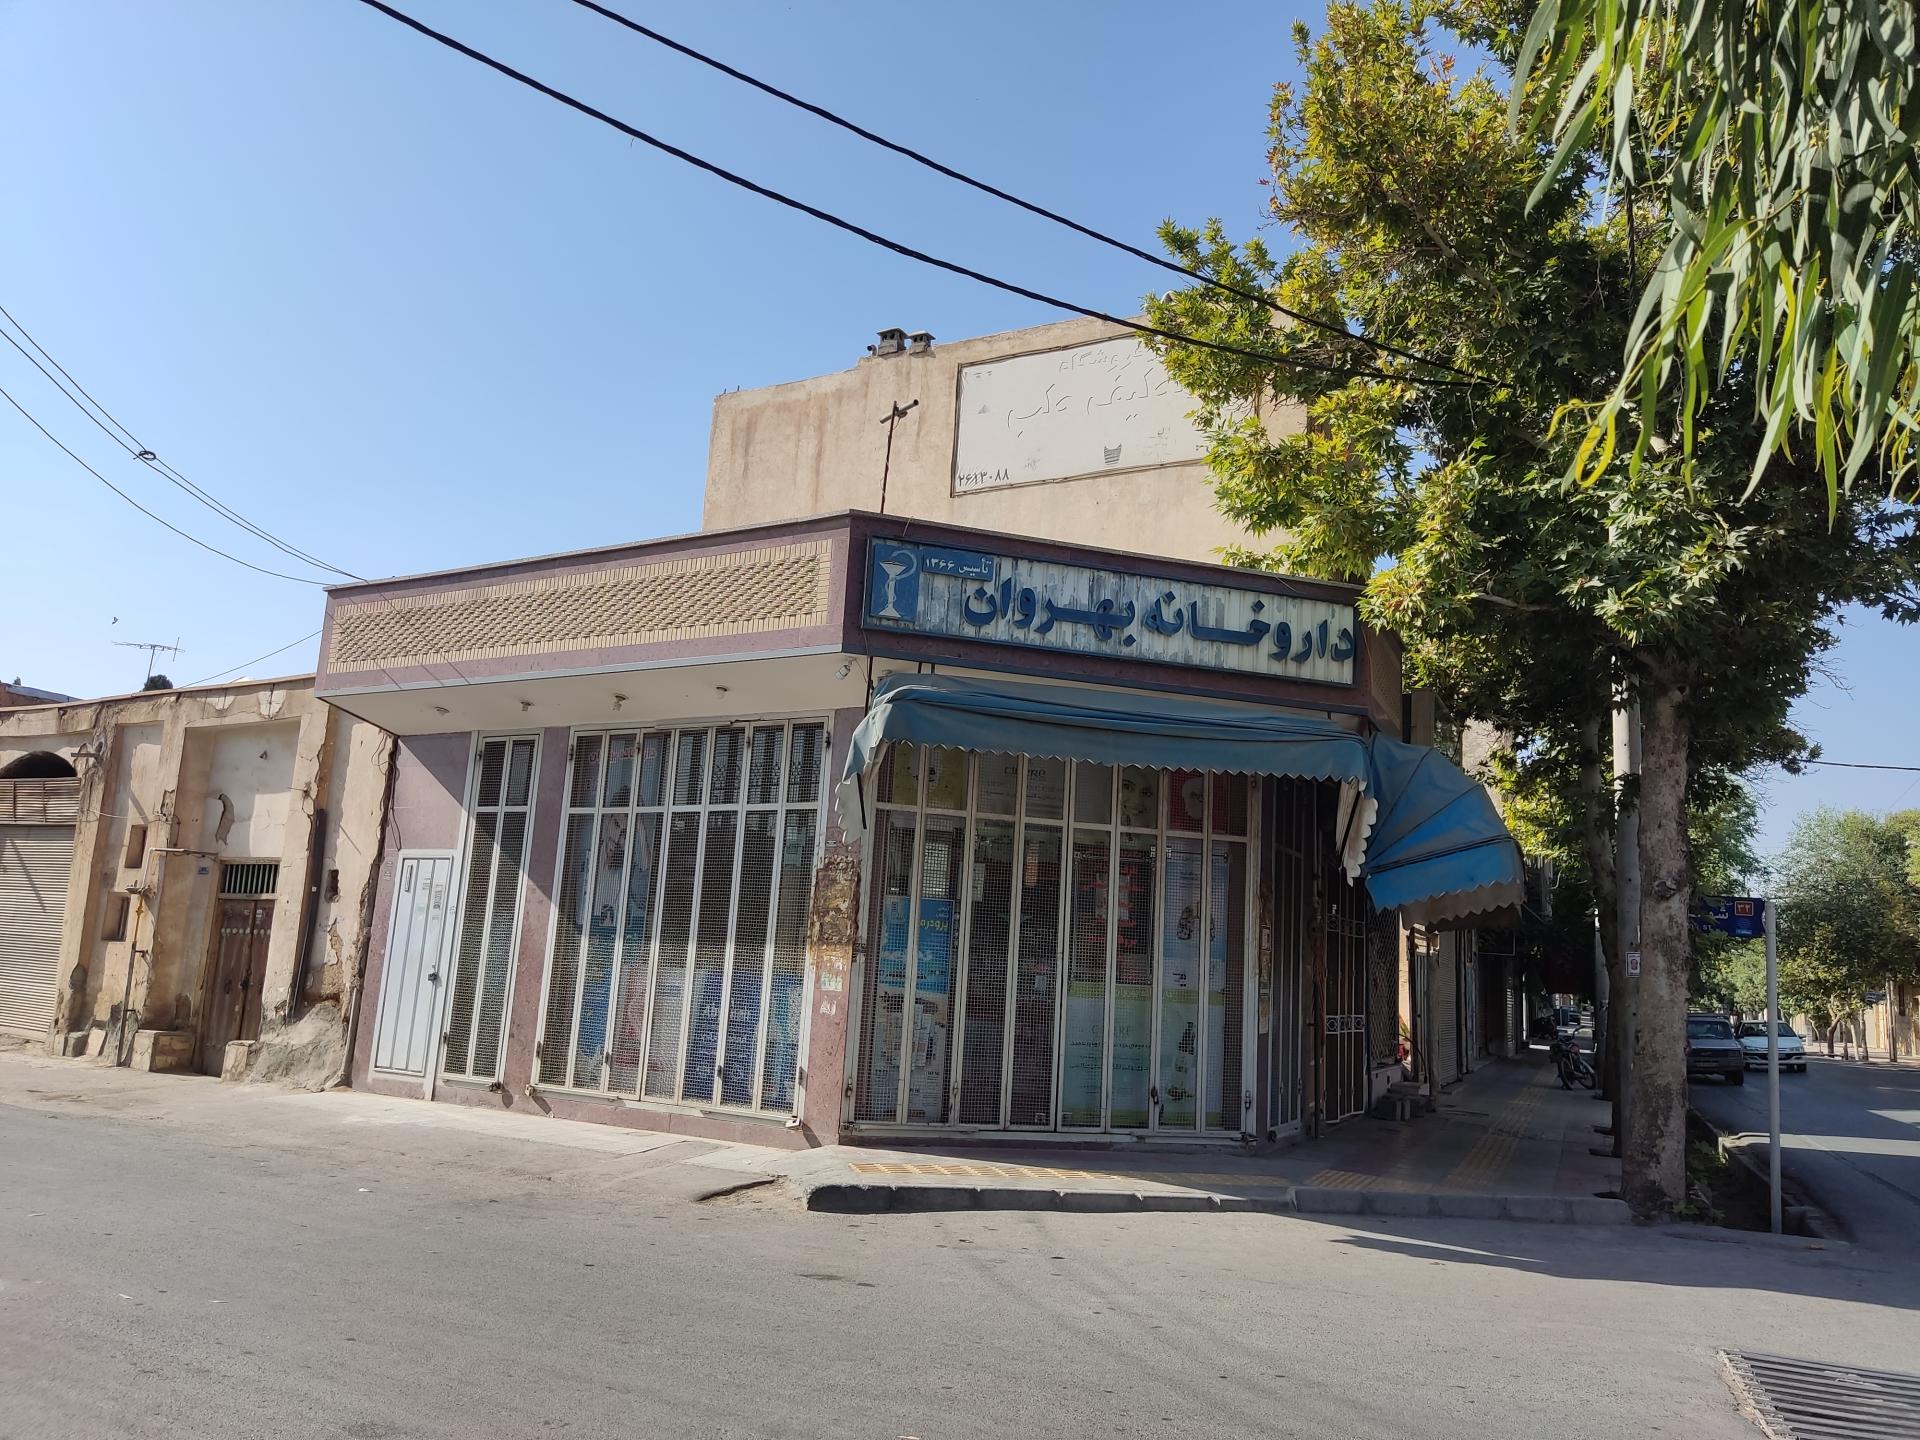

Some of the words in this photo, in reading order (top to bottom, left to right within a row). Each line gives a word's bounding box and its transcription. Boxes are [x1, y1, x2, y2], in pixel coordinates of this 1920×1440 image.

[926, 557, 955, 570] ۱۳۶۶
[958, 557, 992, 576] تأسیس
[963, 577, 1137, 647] بهروان
[1143, 590, 1354, 664] داروخانه
